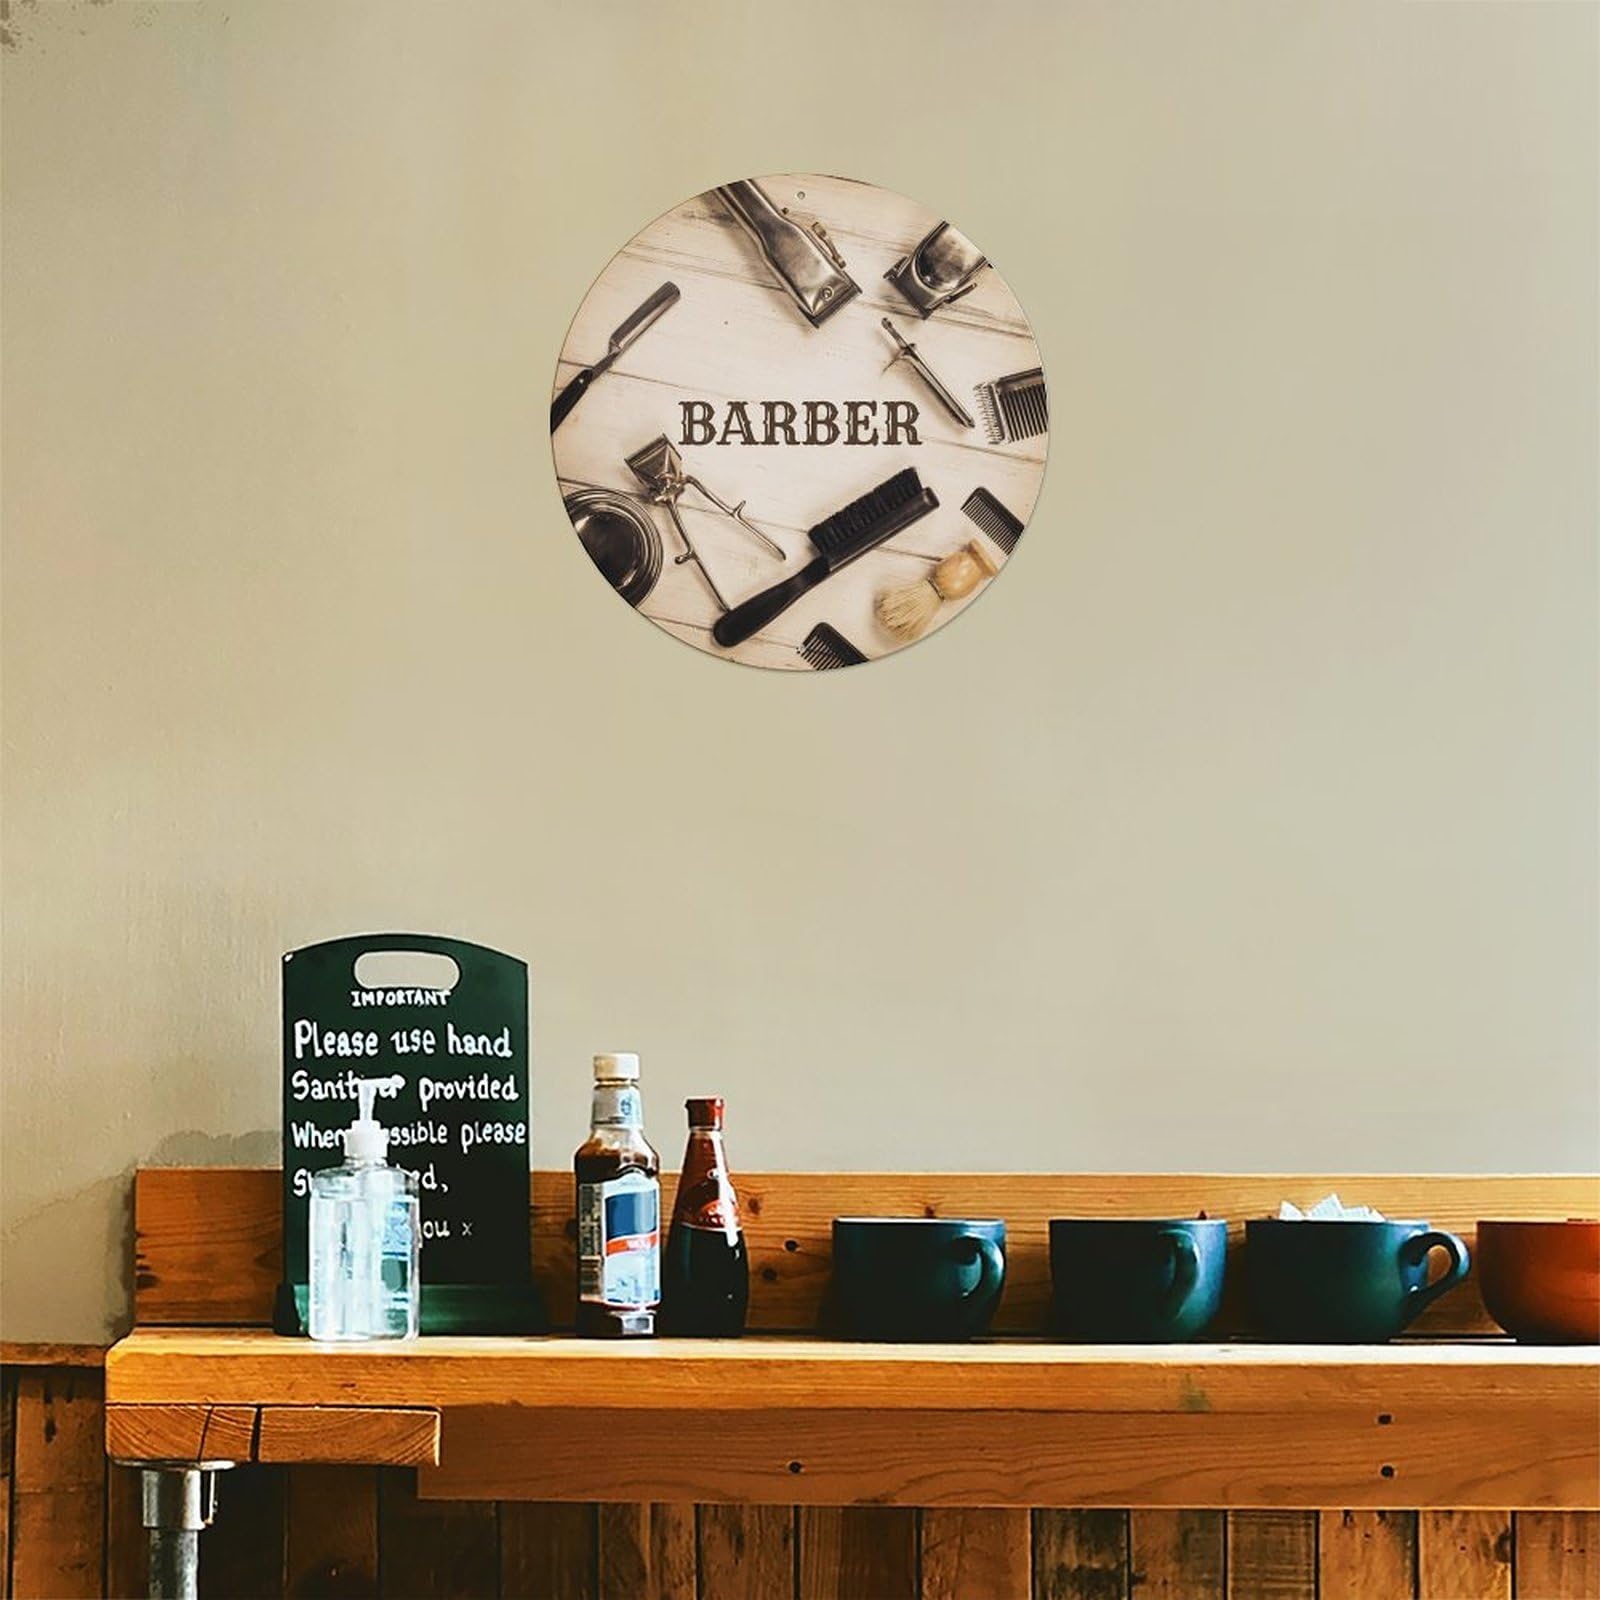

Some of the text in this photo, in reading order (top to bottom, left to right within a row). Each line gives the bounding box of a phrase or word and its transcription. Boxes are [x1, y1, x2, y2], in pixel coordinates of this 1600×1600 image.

[678, 400, 923, 446] BARBER
[350, 989, 451, 1007] IMPORTANT
[294, 1019, 513, 1059] Please use hand
[418, 1073, 520, 1113] provided
[460, 1121, 526, 1154] please
